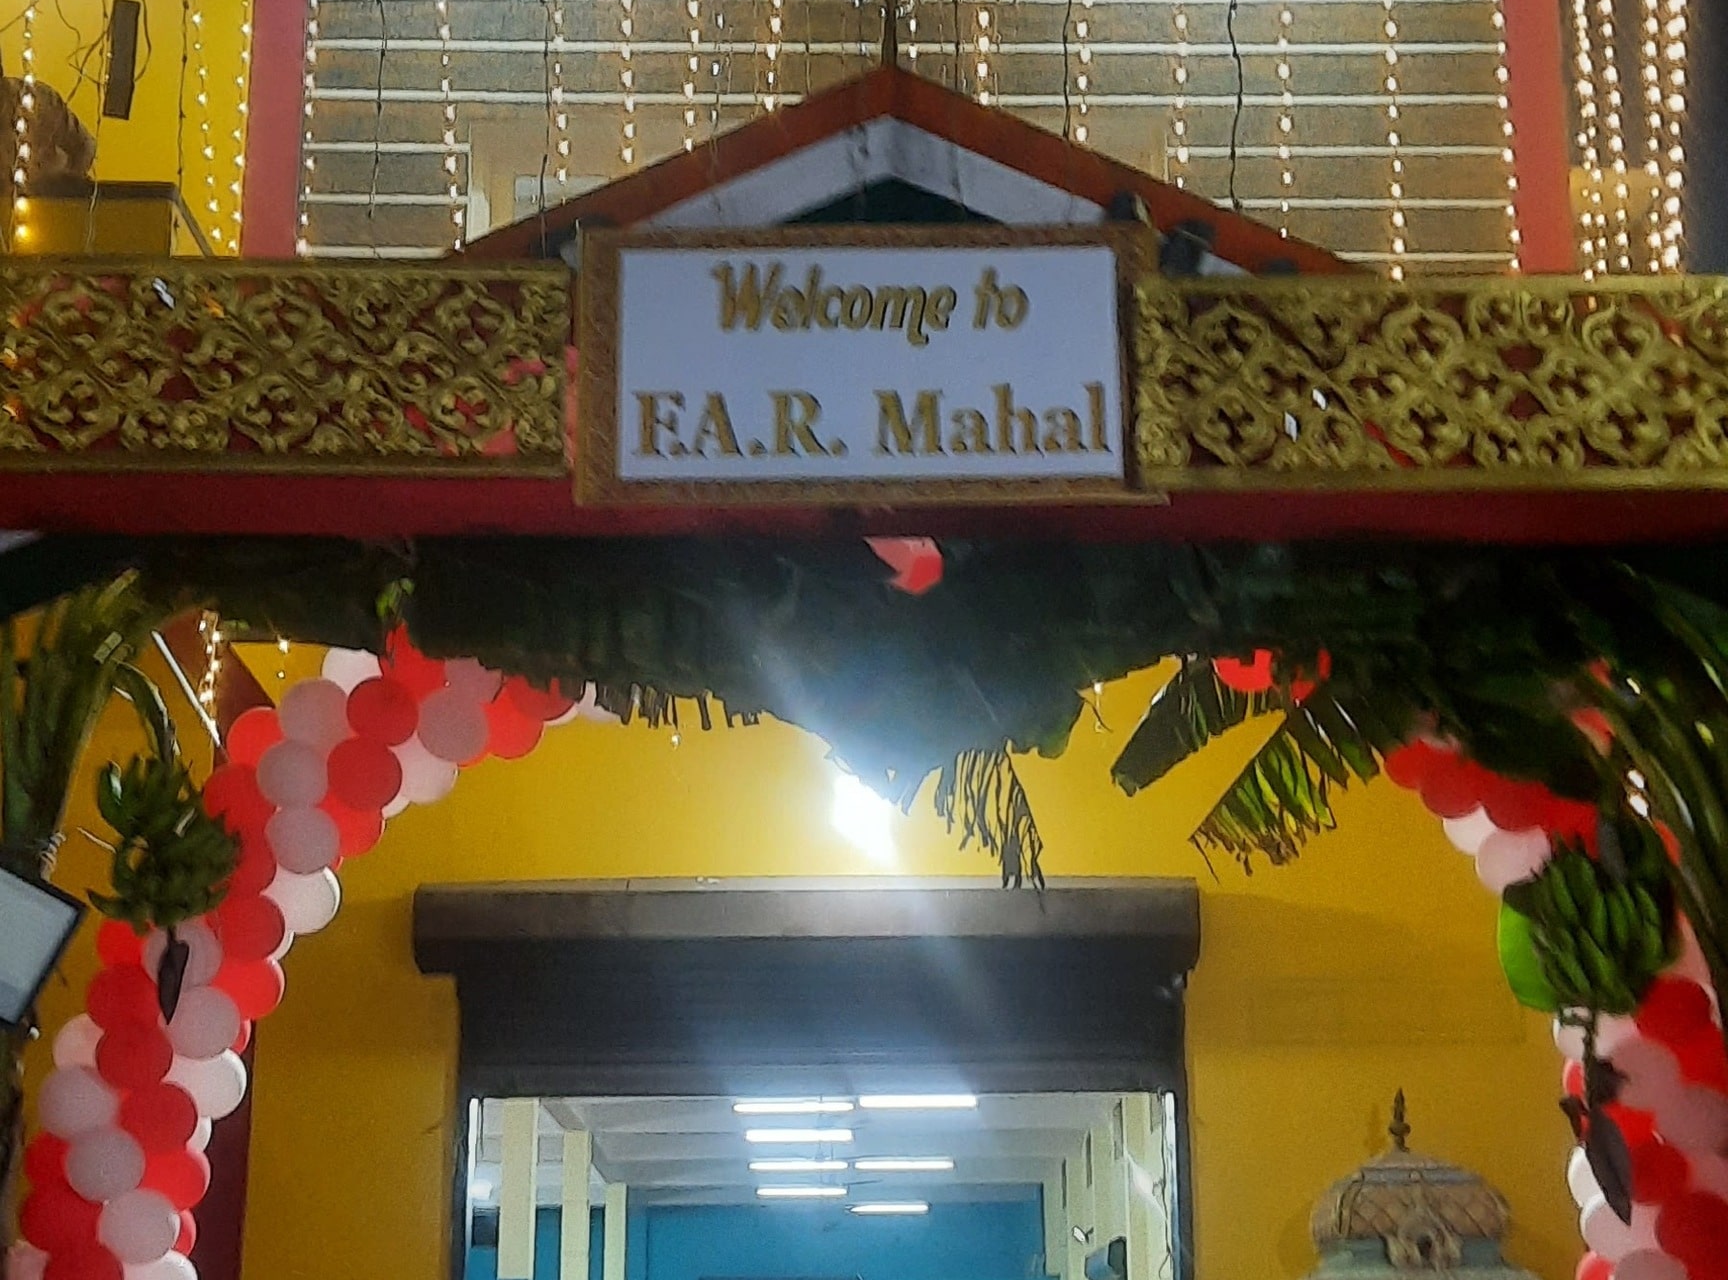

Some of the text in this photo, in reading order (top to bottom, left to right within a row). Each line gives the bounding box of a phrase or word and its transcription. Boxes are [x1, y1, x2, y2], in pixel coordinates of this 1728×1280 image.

[709, 261, 1030, 347] Welcome to
[872, 380, 1113, 458] Mahal
